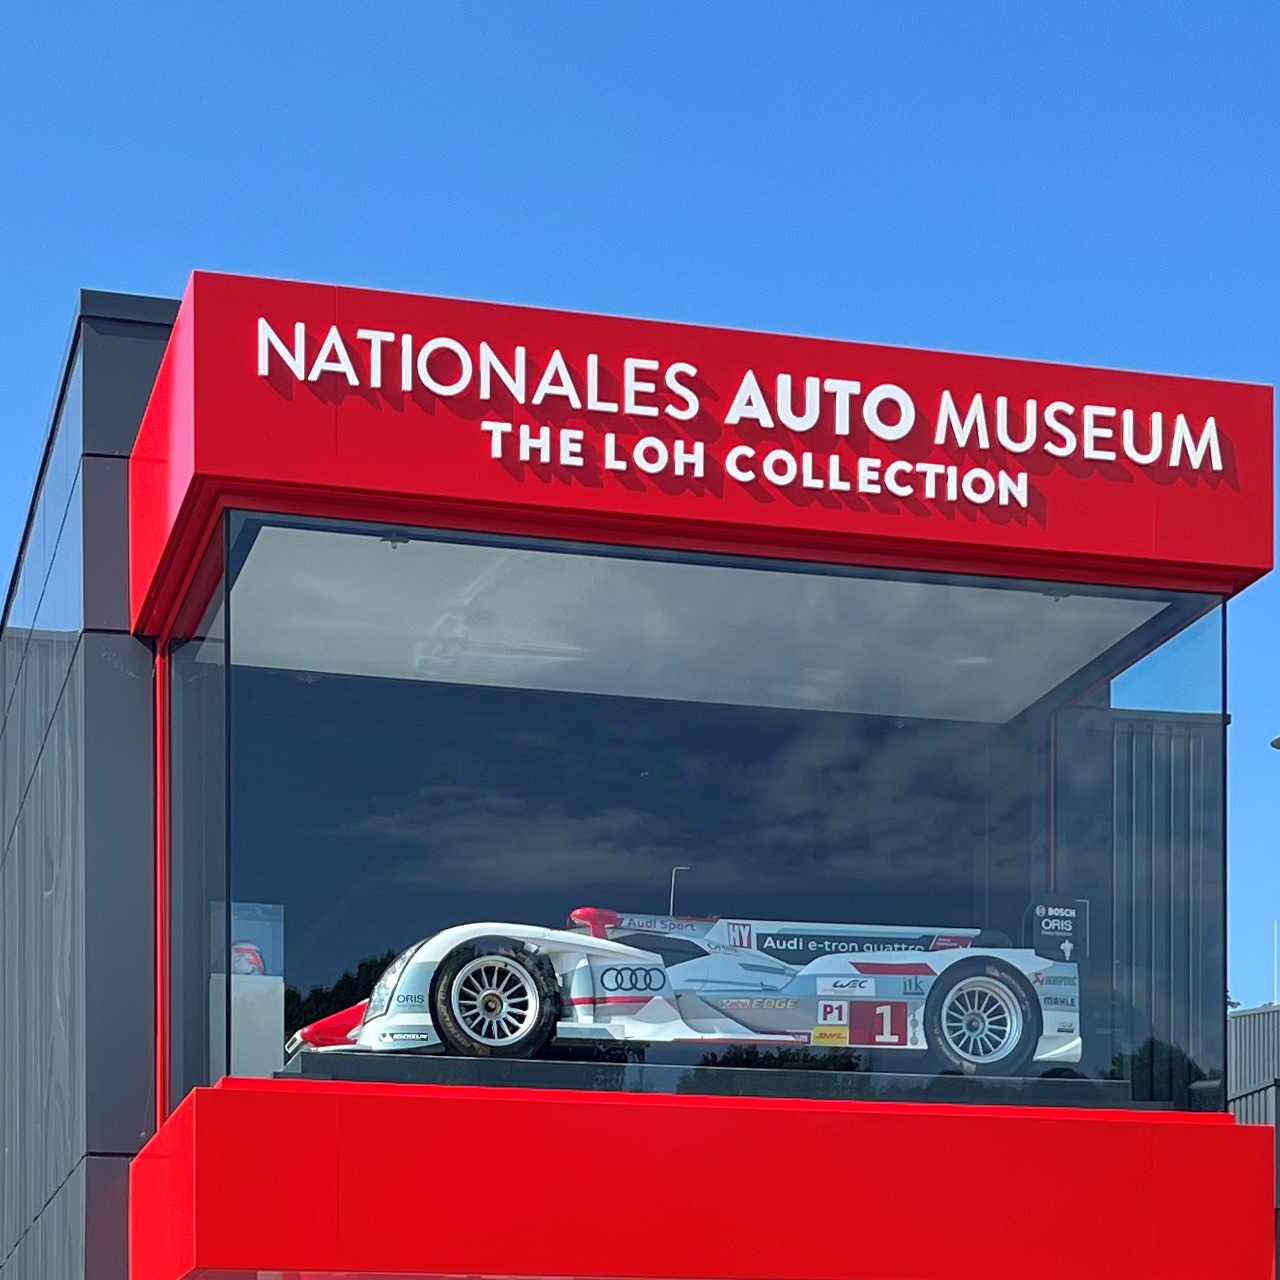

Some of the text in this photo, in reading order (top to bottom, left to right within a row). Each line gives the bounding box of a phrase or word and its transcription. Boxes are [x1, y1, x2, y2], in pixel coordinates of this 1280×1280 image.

[257, 317, 1223, 471] NATIONALES AUTO MUSEUM
[481, 420, 1028, 508] THE LOH COLLECTION
[1047, 907, 1076, 918] BOSCH
[626, 918, 696, 932] Audi Sport
[1041, 918, 1073, 931] ORIS
[729, 923, 752, 949] HY
[762, 936, 803, 950] Audi
[807, 939, 860, 952] e-tron
[396, 994, 425, 1004] ORIS
[751, 999, 798, 1010] EDGE
[1043, 996, 1076, 1008] MAHLE
[822, 1003, 844, 1022] P1
[874, 1005, 900, 1043] 1
[817, 1032, 847, 1040] DHL
